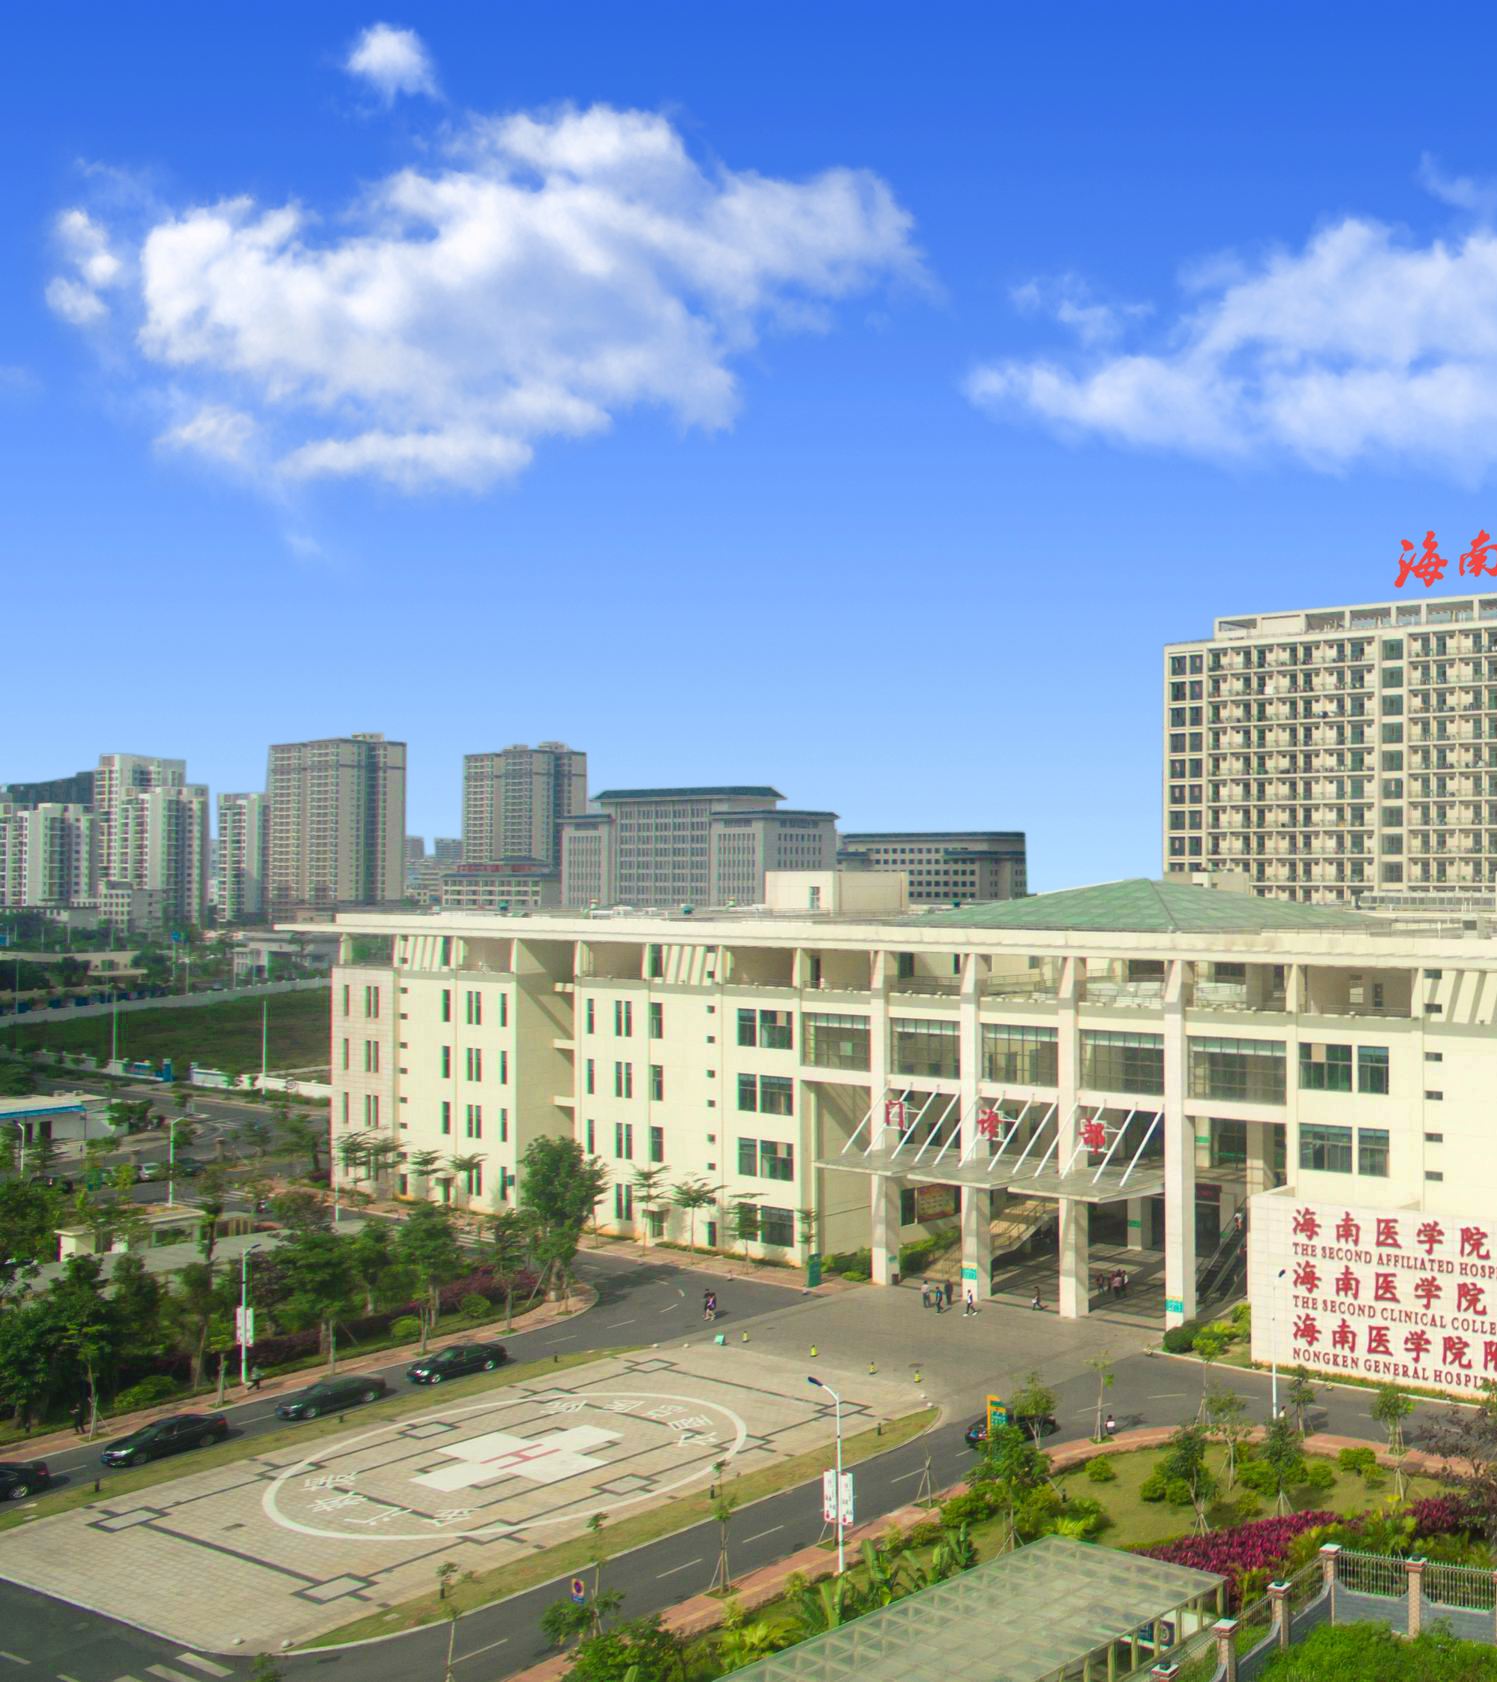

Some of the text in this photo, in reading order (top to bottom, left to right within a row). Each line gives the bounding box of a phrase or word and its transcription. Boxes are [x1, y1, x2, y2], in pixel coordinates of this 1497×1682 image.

[1293, 1242, 1317, 1257] THE
[1321, 1246, 1372, 1264] SECOND
[1377, 1254, 1454, 1274] AFFILIATED
[1293, 1295, 1318, 1309] THE
[1322, 1298, 1376, 1319] SECOND
[1381, 1307, 1447, 1328] CLINICAL
[1293, 1347, 1359, 1369] NONGKEN
[1364, 1358, 1429, 1381] GENERAL
